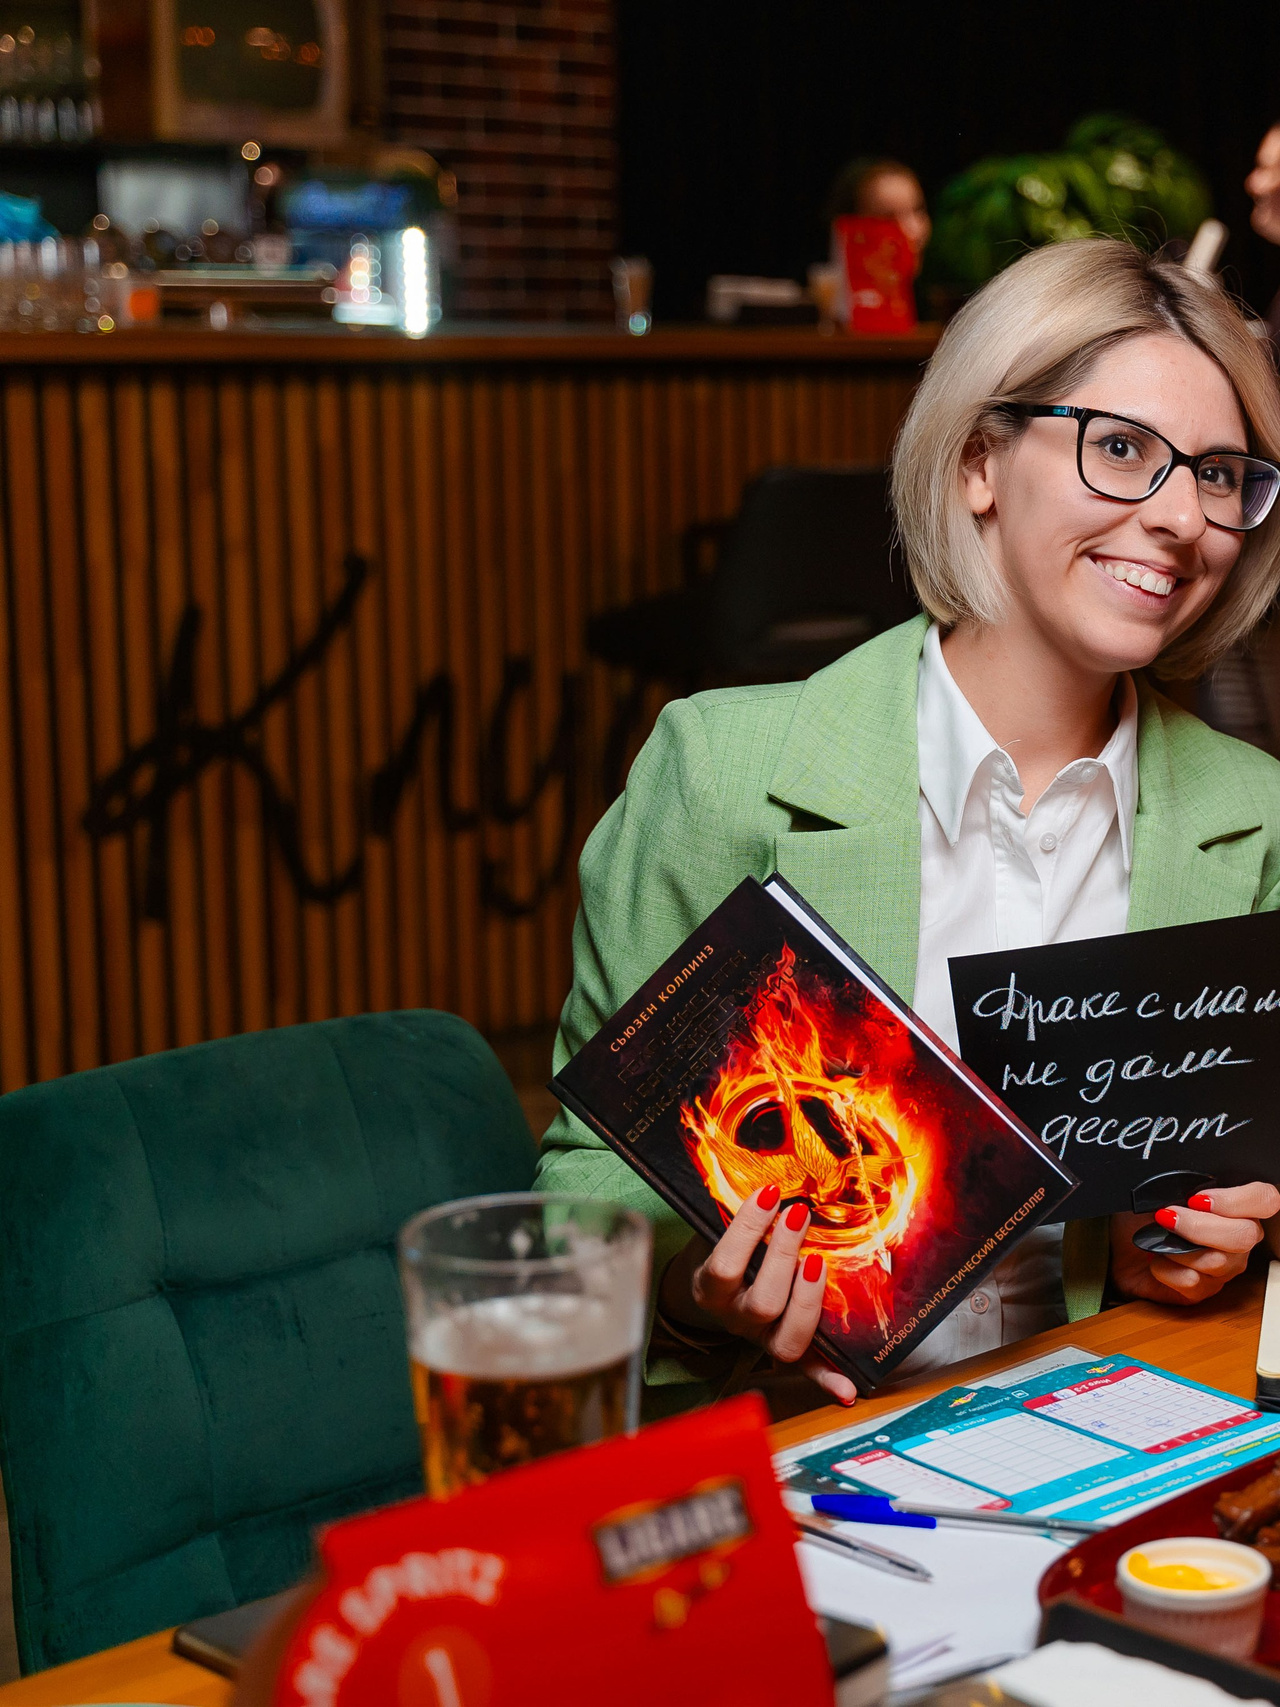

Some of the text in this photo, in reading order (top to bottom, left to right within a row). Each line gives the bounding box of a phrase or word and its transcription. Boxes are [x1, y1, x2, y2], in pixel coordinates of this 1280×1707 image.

[610, 944, 714, 1053] СЬЮЗЕН КОЛЛИНЗ
[1136, 992, 1165, 1018] с
[1002, 1046, 1254, 1103] не дали
[1041, 1112, 1254, 1160] десерт
[873, 1186, 1046, 1364] МИРОВОЙ ФАНТАСТИЧЕСКИЙ БЕСТСЕЛЛЕР
